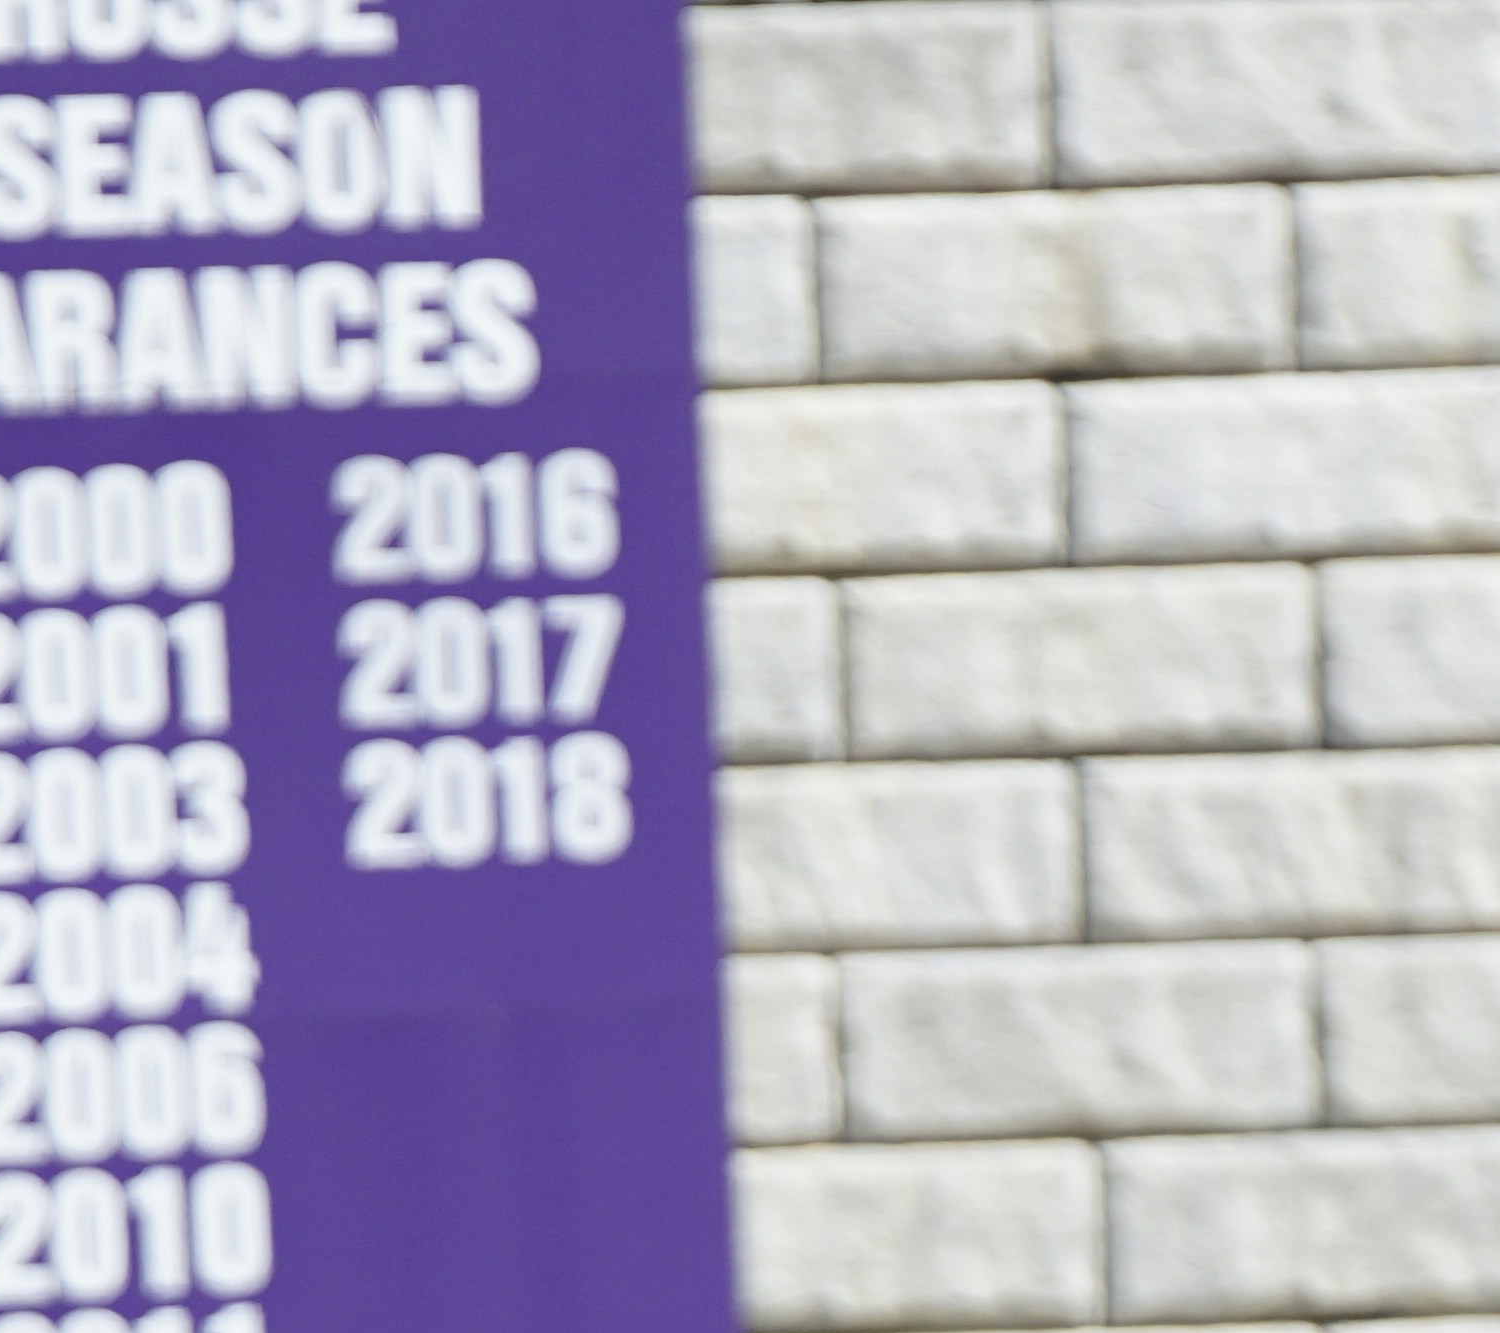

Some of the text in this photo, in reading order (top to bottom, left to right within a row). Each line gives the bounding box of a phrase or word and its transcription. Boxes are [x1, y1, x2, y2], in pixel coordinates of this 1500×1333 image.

[333, 449, 619, 584] 2016
[339, 594, 624, 728] 2017
[344, 732, 633, 869] 2018
